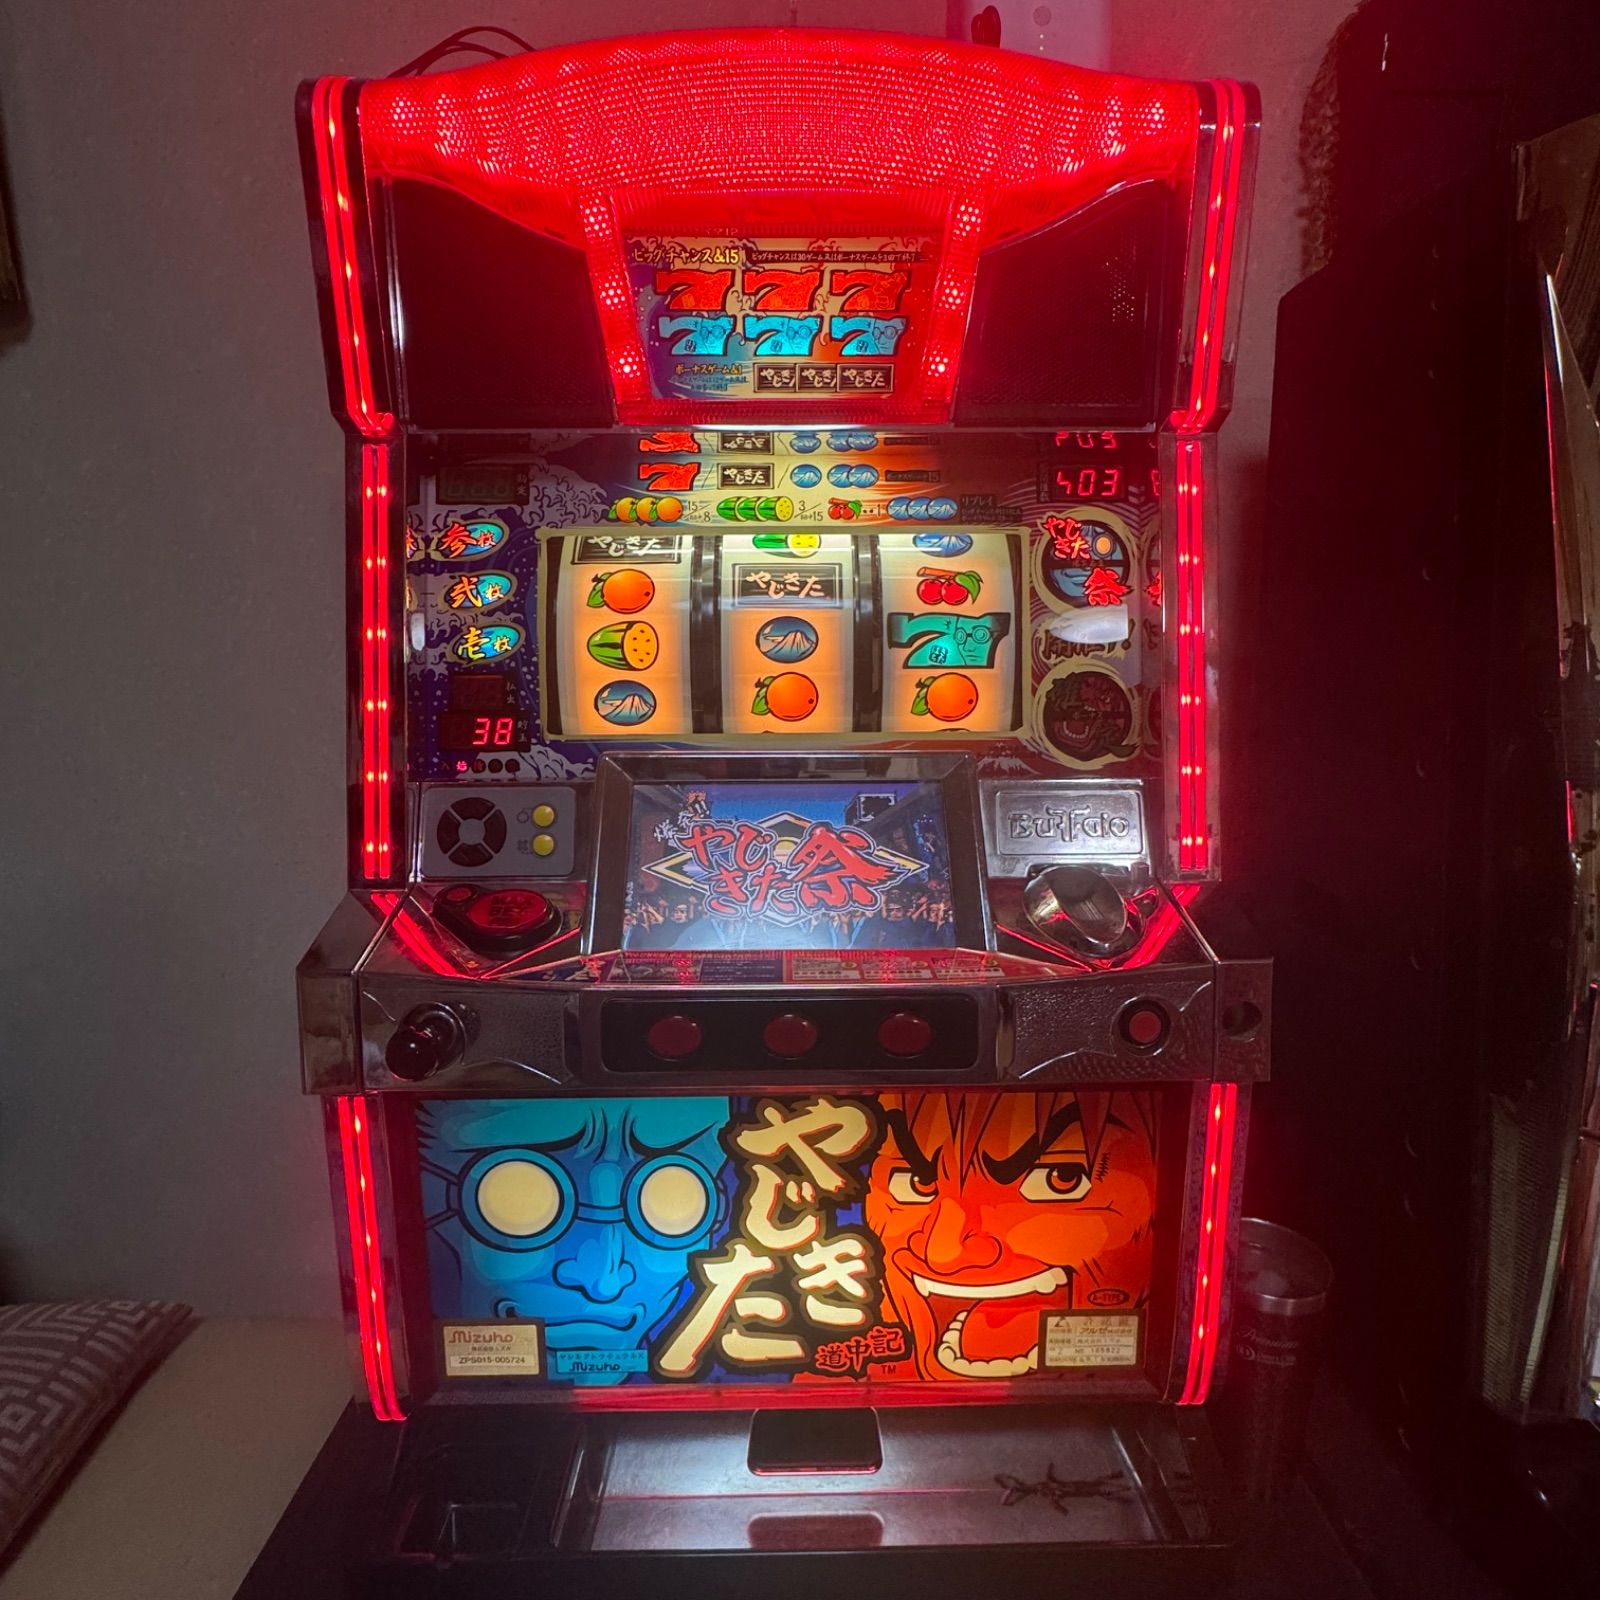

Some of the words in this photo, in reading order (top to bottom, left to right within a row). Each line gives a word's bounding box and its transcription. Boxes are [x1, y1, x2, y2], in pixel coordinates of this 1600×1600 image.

[723, 467, 766, 485] やじきた
[746, 570, 825, 599] やじきた
[472, 718, 513, 745] 38
[448, 1329, 514, 1344] Mizuho
[815, 1326, 905, 1373] 道中記
[569, 1361, 621, 1372] Mizuho
[881, 1364, 897, 1375] TM
